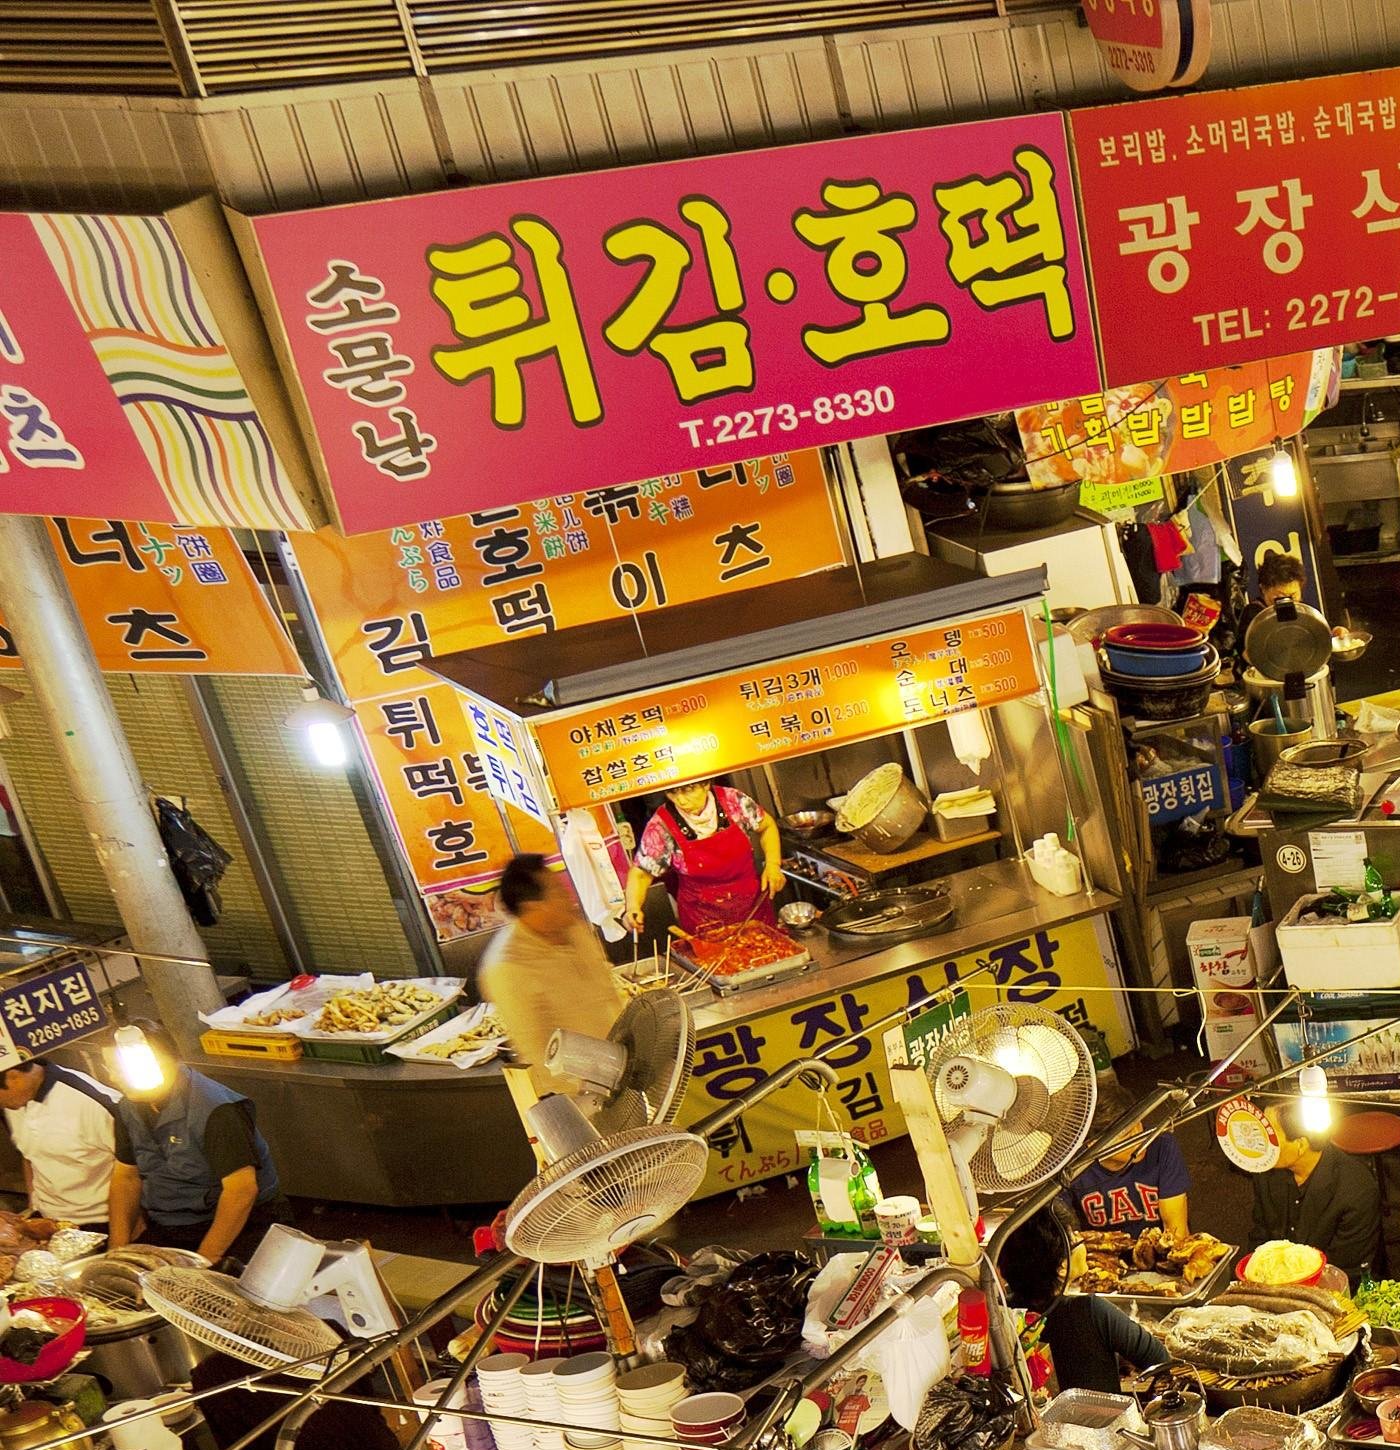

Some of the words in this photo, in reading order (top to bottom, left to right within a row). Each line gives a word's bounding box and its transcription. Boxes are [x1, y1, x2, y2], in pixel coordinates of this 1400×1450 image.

[1107, 45, 1155, 75] 2272-3318
[1193, 306, 1274, 348] TEL:
[306, 260, 437, 482] 소문난
[680, 385, 895, 449] T.2273-8330
[890, 629, 962, 660] 오뎅
[982, 621, 1006, 640] 500
[739, 668, 822, 701] 튀김3개
[896, 657, 968, 687] 순대
[904, 685, 977, 716] 도너츠
[994, 676, 1017, 695] 500
[569, 705, 665, 745] 야채호떡
[682, 695, 709, 715] 800
[750, 707, 831, 740] 떡볶이
[581, 749, 674, 787] 찹쌀호떡
[1280, 850, 1303, 867] 4-26
[4, 972, 92, 1028] 천지집
[27, 1007, 100, 1048] 2269-1835
